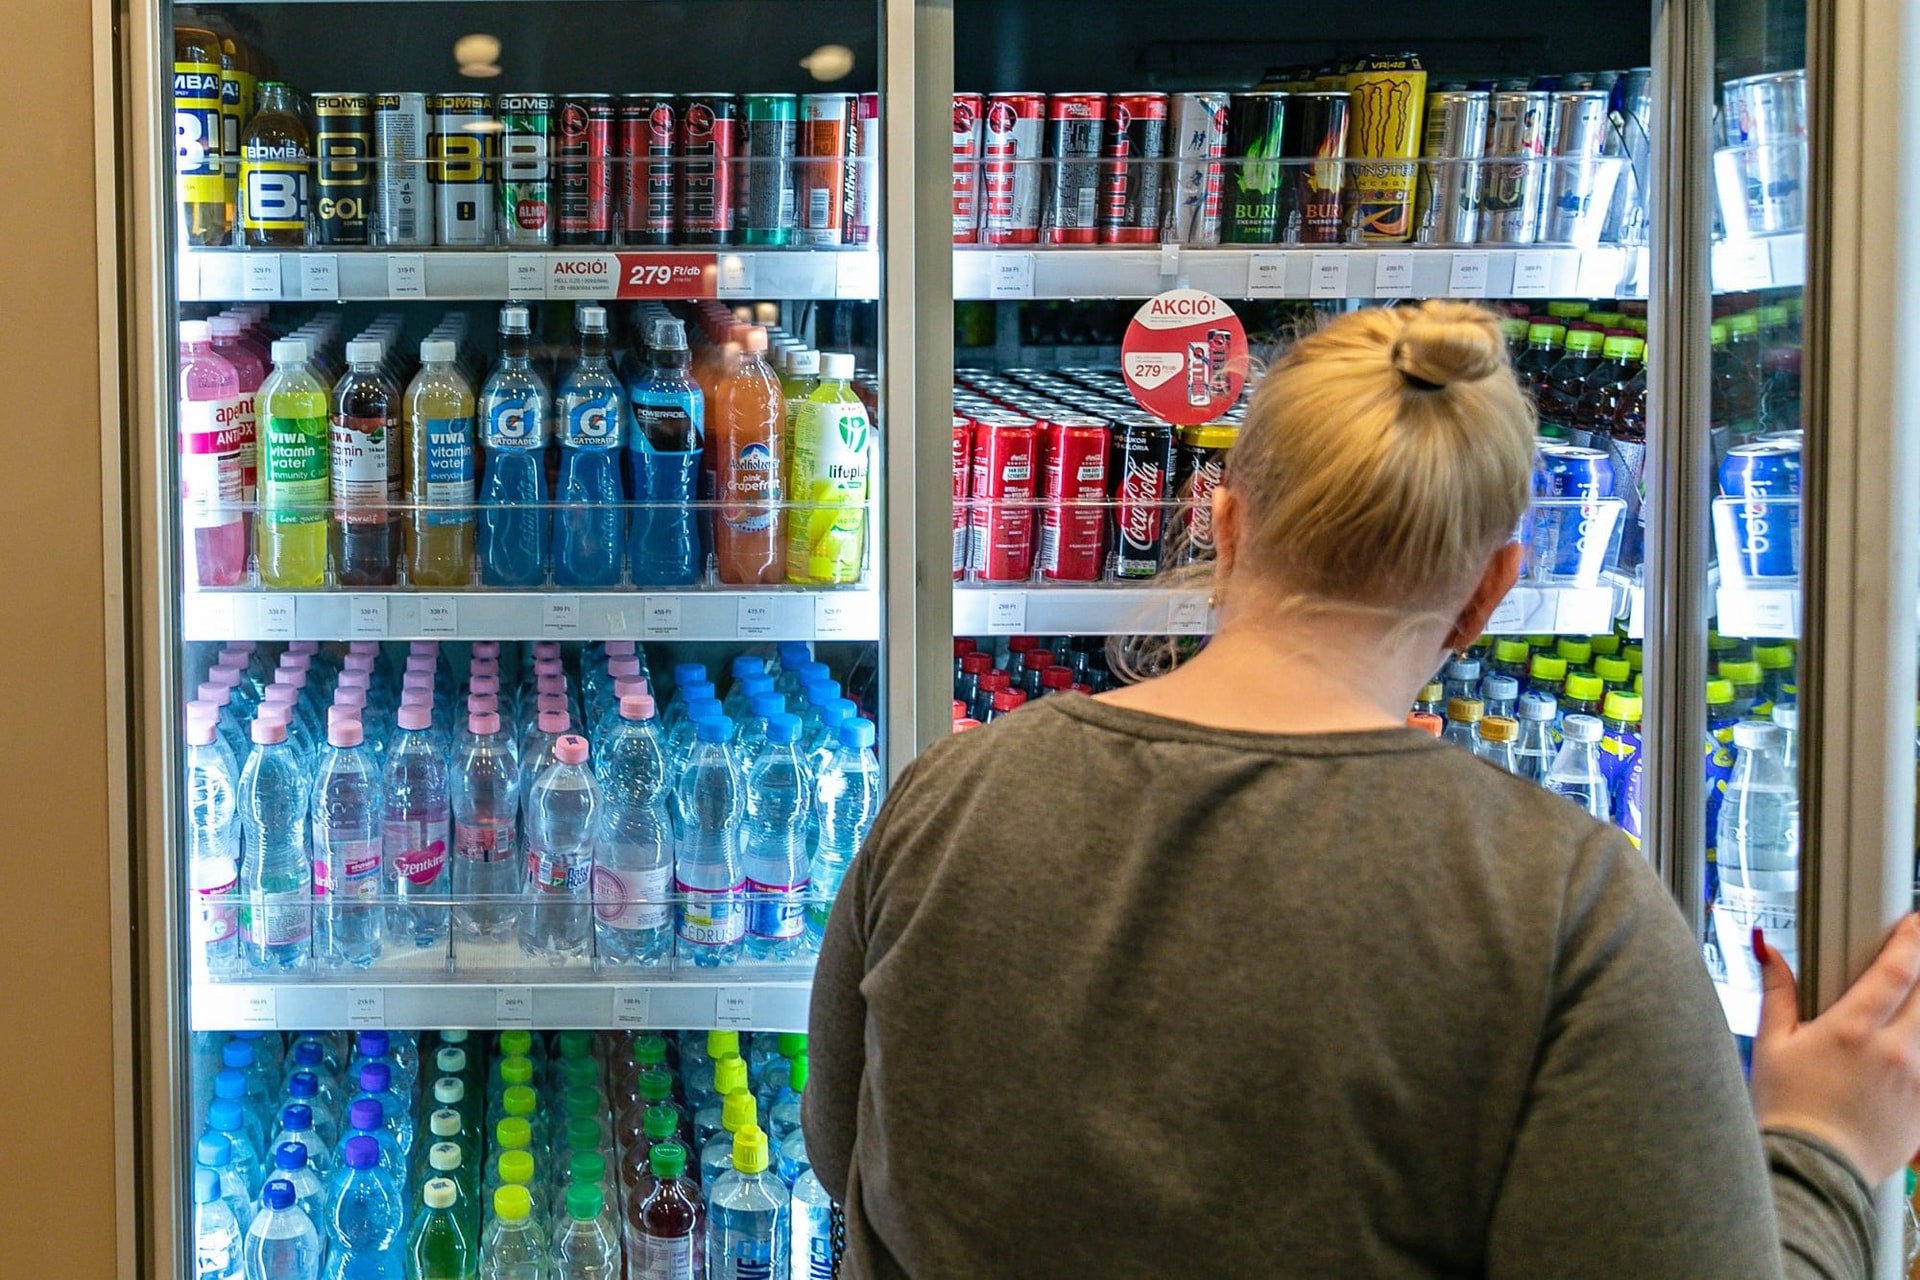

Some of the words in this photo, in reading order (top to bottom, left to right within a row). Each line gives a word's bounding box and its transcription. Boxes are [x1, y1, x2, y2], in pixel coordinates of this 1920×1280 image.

[560, 142, 588, 218] HELL
[648, 142, 675, 218] HELL
[684, 142, 715, 218] HELL
[984, 140, 1017, 218] HELL
[1306, 204, 1342, 219] BUR
[554, 259, 607, 274] AKCIÓ!
[629, 265, 672, 285] 279
[673, 266, 700, 276] Ft/db
[1151, 295, 1216, 315] AKCIÓ!
[1135, 364, 1161, 377] 279
[498, 407, 524, 438] G
[581, 407, 607, 438] G
[431, 433, 466, 444] VIWA
[431, 446, 472, 457] vitamin
